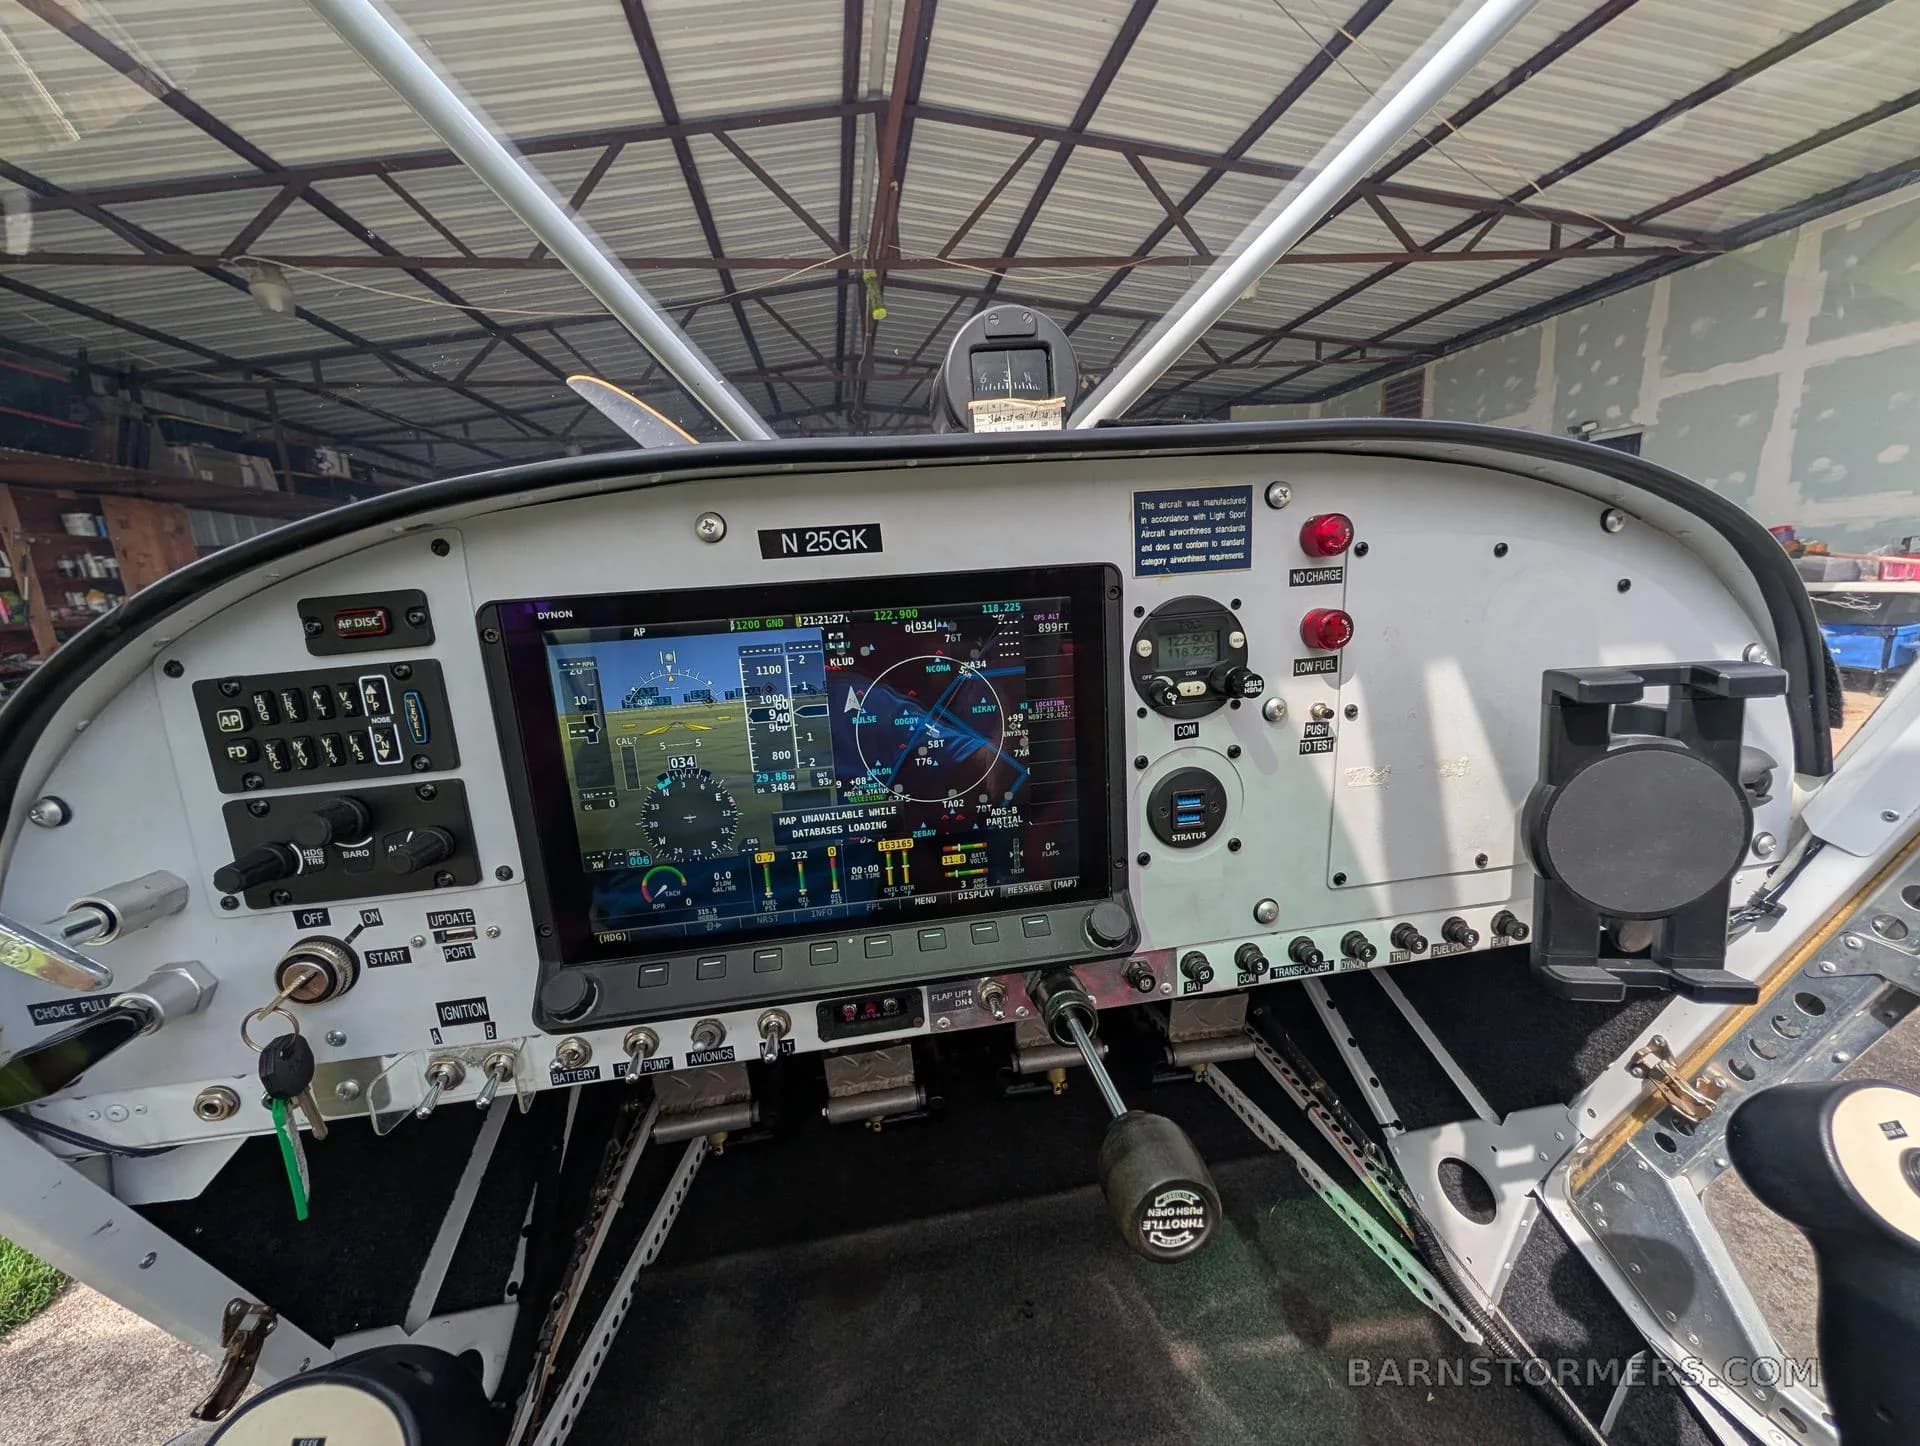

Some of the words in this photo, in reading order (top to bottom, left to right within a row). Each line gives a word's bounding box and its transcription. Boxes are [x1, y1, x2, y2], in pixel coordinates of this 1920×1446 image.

[980, 374, 986, 383] 6
[1004, 371, 1010, 382] 3
[1024, 372, 1032, 382] N
[1141, 502, 1154, 510] This
[1159, 500, 1182, 509] aircraft
[1204, 496, 1246, 506] manufactured
[1151, 514, 1189, 523] accordance
[1193, 512, 1206, 521] with
[1210, 511, 1225, 521] Light
[1229, 510, 1246, 519] Sport
[1141, 528, 1165, 538] Aircraft
[1169, 526, 1211, 536] airworthiness
[1215, 524, 1246, 533] standards
[782, 533, 798, 553] N
[805, 528, 868, 552] 25GK
[1142, 544, 1152, 552] and
[1156, 543, 1170, 551] does
[1186, 540, 1208, 549] conform
[1221, 538, 1244, 546] standard
[1142, 557, 1166, 566] category
[1170, 554, 1206, 564] airworthiness
[1209, 552, 1244, 561] requirements
[1293, 571, 1306, 584] NO
[1307, 568, 1342, 583] CHARGE
[982, 603, 1021, 613] 118.225
[537, 610, 573, 620] DYNON
[874, 609, 918, 620] 122.900
[338, 620, 352, 629] AP
[354, 616, 380, 627] DISC
[736, 620, 760, 630] 1200
[766, 619, 784, 628] GND
[803, 614, 843, 626] 21:21:27
[916, 621, 932, 630] 034
[1038, 623, 1069, 633] 899FT
[633, 627, 645, 637] AP
[945, 633, 961, 642] 76T
[830, 657, 854, 666] KLUD
[1296, 659, 1313, 674] LOW
[1314, 657, 1335, 671] FUEL
[756, 665, 781, 676] 1100
[1245, 680, 1262, 688] STEP
[312, 691, 326, 716] ALT
[339, 691, 352, 710] VS
[366, 694, 380, 711] UP
[575, 696, 587, 705] 10
[254, 695, 270, 720] HDG
[281, 693, 298, 719] TRK
[222, 715, 239, 727] AP
[407, 699, 421, 737] LEVEL
[1008, 714, 1024, 722] +99
[1177, 724, 1196, 736] COM
[1306, 723, 1327, 736] PUSH
[374, 734, 389, 749] DN
[616, 737, 637, 745] CAL?
[928, 740, 944, 749] 58T
[1300, 741, 1310, 753] TO
[1311, 739, 1333, 752] TEST
[228, 746, 247, 758] FD
[349, 736, 364, 760] IAS
[265, 744, 281, 770] SRC
[293, 741, 308, 766] NAV
[772, 750, 790, 760] 800
[670, 757, 695, 769] 034
[915, 757, 932, 767] T76
[756, 772, 788, 783] 29.88
[850, 777, 866, 786] +08
[770, 782, 796, 792] 3484
[715, 793, 721, 801] E
[942, 800, 964, 808] TA02
[976, 804, 992, 813] 70T
[779, 816, 796, 825] MAP
[802, 810, 864, 824] UNAVAILABLE
[869, 807, 896, 816] WHILE
[991, 807, 1018, 816] ADS-B
[986, 816, 1023, 826] PARTIAL
[792, 825, 842, 838] DATABASES
[849, 821, 887, 832] LOADING
[1172, 832, 1206, 841] STRATUS
[342, 850, 369, 858] BARO
[791, 851, 808, 860] 122
[307, 857, 324, 865] TRK
[592, 861, 604, 869] XW
[630, 856, 649, 865] 006
[852, 865, 879, 874] 00:00
[714, 871, 731, 880] 0.0
[1008, 884, 1044, 894] MESSAGE
[1054, 880, 1077, 890] (MAP)
[958, 889, 995, 900] DISPLAY
[915, 896, 936, 905] MENU
[866, 903, 880, 911] FPL
[302, 912, 324, 925] OFF
[364, 911, 380, 924] ON
[811, 909, 833, 918] INFO
[430, 912, 474, 927] UPDATE
[757, 915, 778, 924] NRST
[1518, 928, 1523, 936] 3
[600, 933, 626, 943] (HDG)
[1468, 935, 1474, 943] 5
[1492, 937, 1509, 947] FLAP
[1417, 942, 1422, 950] 3
[1433, 945, 1450, 955] FUEL
[369, 950, 405, 965] START
[445, 946, 474, 960] PORT
[1365, 949, 1370, 957] 2
[1392, 952, 1409, 961] TRIM
[1312, 955, 1317, 964] 3
[1257, 962, 1263, 970] 3
[1274, 962, 1329, 976] TRANSPONDER
[1200, 971, 1210, 980] 20
[1240, 974, 1256, 984] COM
[932, 993, 953, 1002] FLAP
[955, 999, 967, 1007] DN
[34, 1004, 76, 1020] CHOKE
[441, 1002, 487, 1021] IGNITION
[487, 1025, 494, 1038] B
[432, 1031, 441, 1044] A
[690, 1049, 734, 1064] AVIONICS
[643, 1058, 670, 1071] PUMP
[552, 1069, 596, 1084] BATTERY
[1148, 1208, 1175, 1216] OPEN
[1176, 1207, 1203, 1215] PUSH
[1142, 1219, 1204, 1230] THROTTLE
